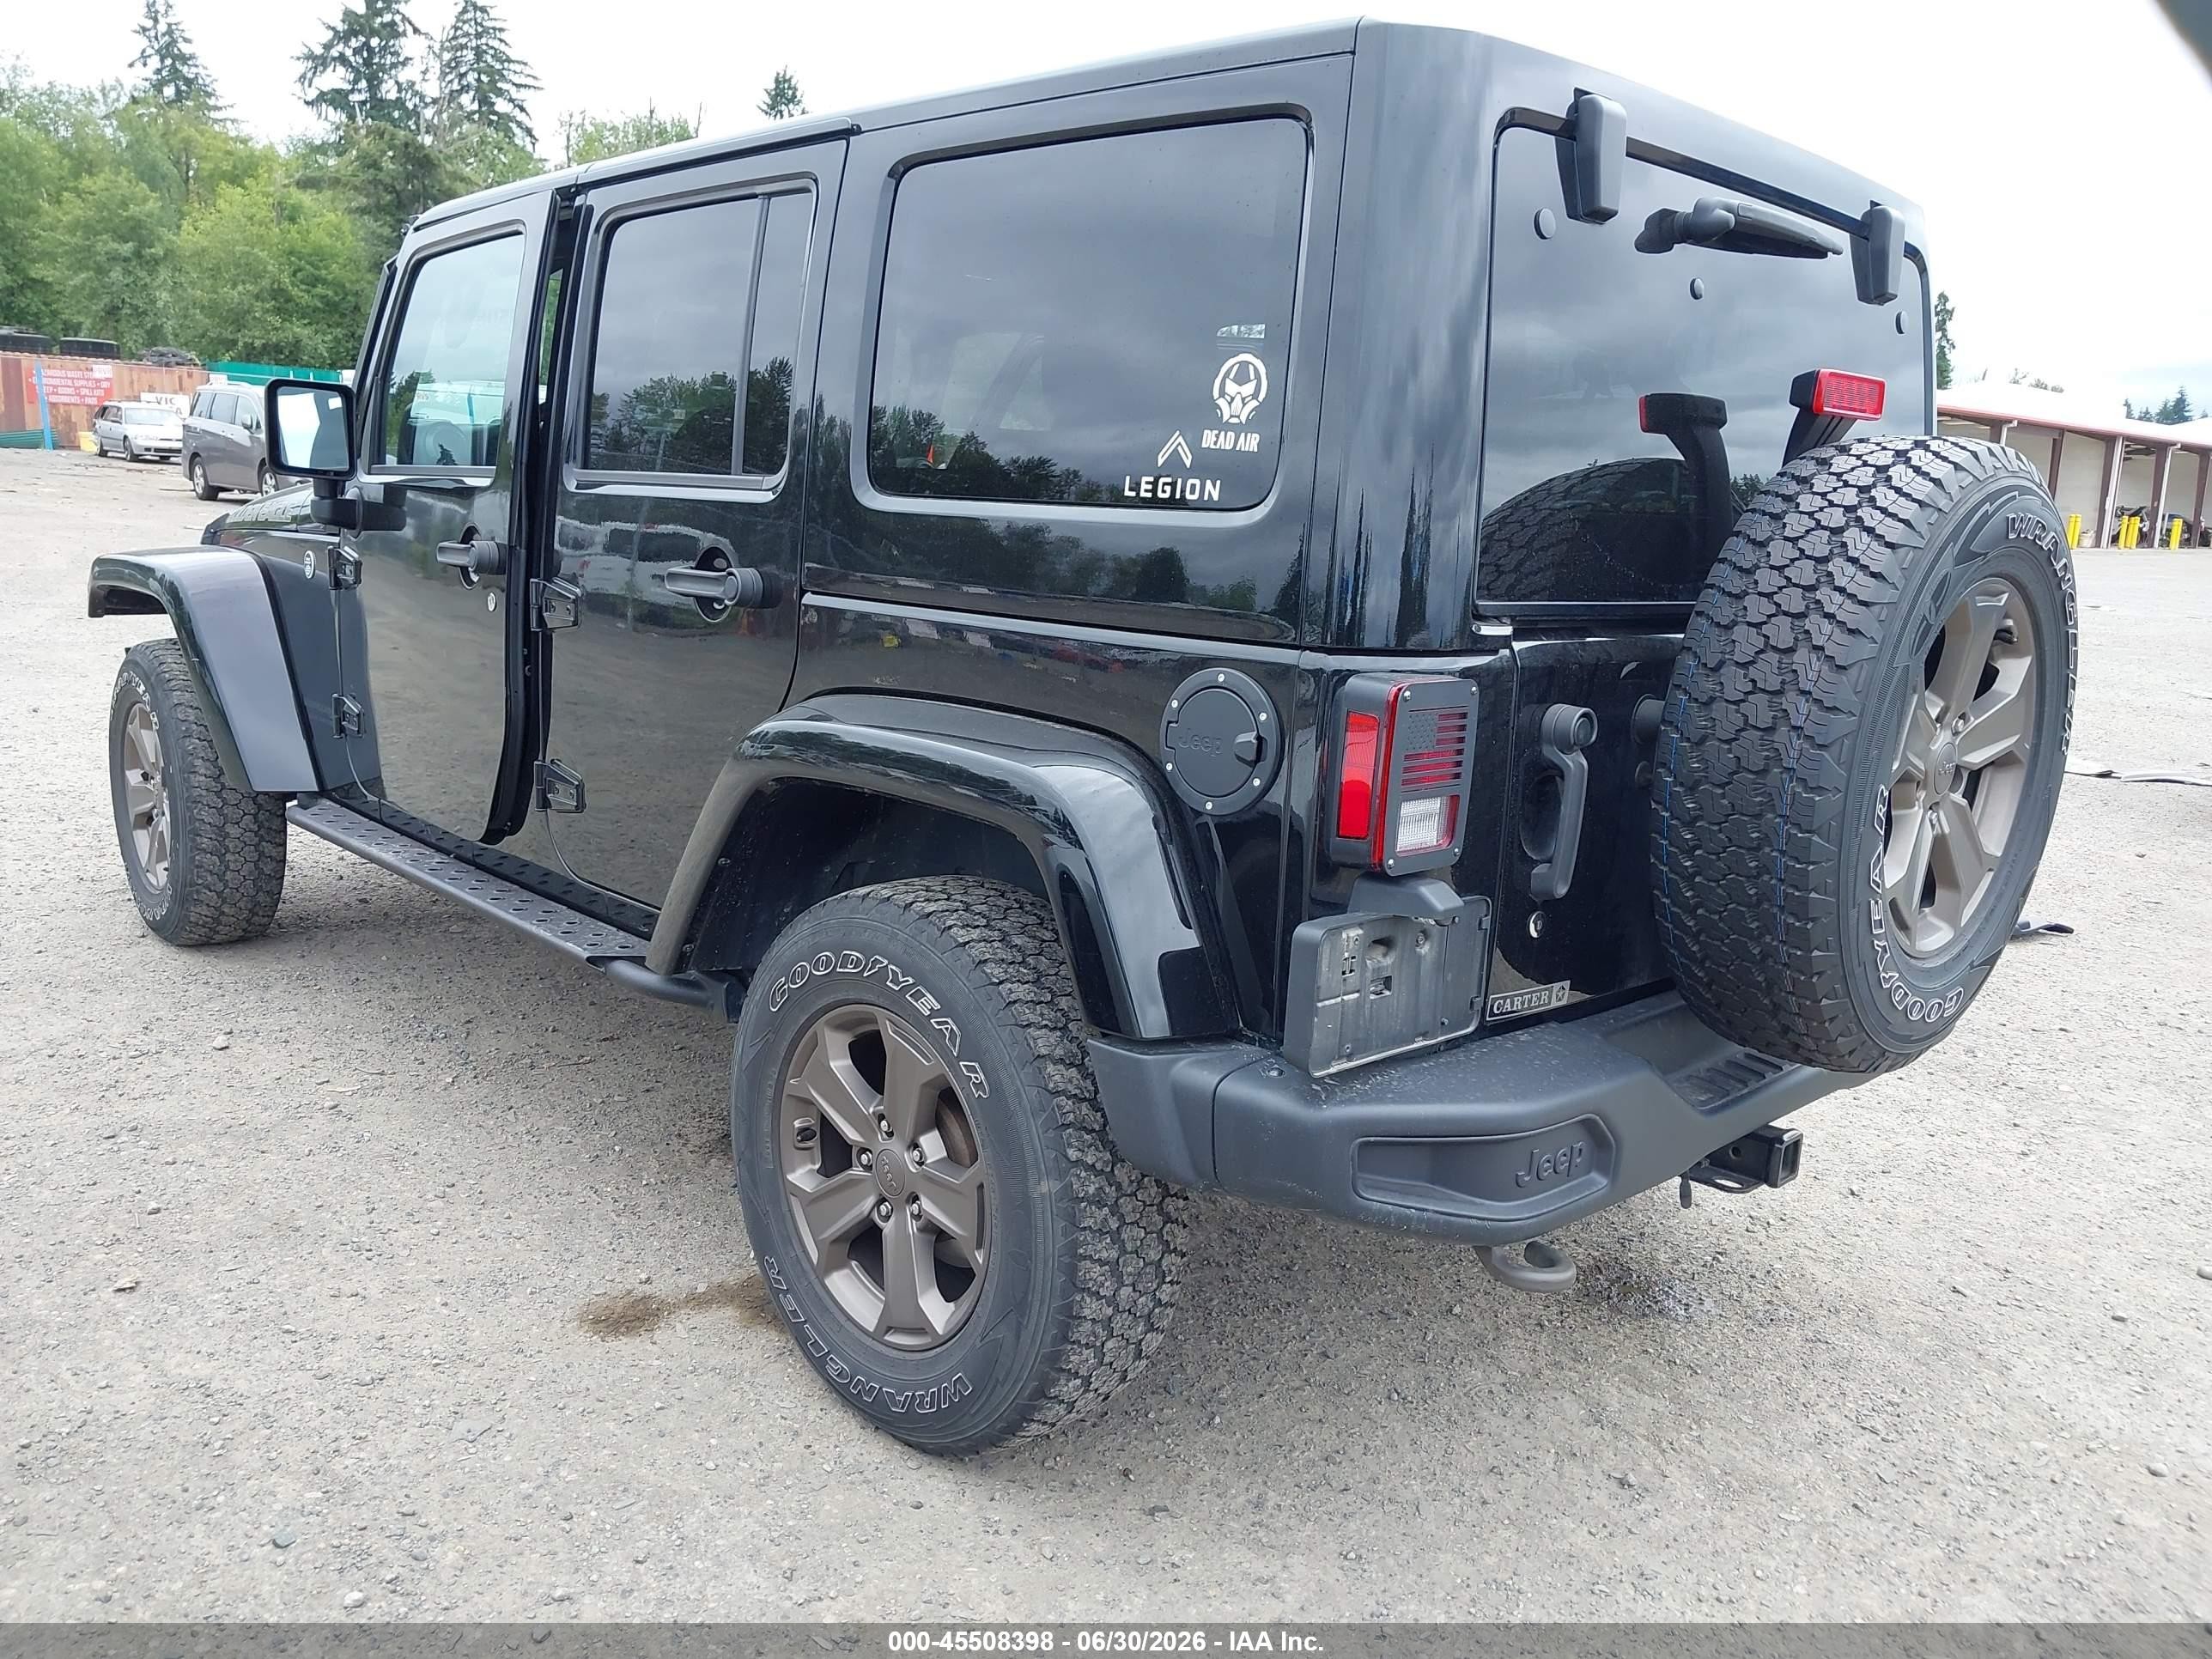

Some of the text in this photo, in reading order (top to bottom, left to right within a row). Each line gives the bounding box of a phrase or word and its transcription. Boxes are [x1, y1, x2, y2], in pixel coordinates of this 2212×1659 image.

[1201, 429, 1261, 453] DEAD AIR
[1123, 475, 1221, 501] LEGION
[2006, 512, 2079, 756] WRANGLER
[1179, 728, 1223, 757] Jeep
[1870, 784, 1964, 1023] GOODYEAR
[769, 950, 990, 1099] GOODYEAR
[1492, 990, 1549, 1014] CARTER
[1516, 1140, 1585, 1188] Jeep
[763, 1255, 973, 1413] WRANGLER
